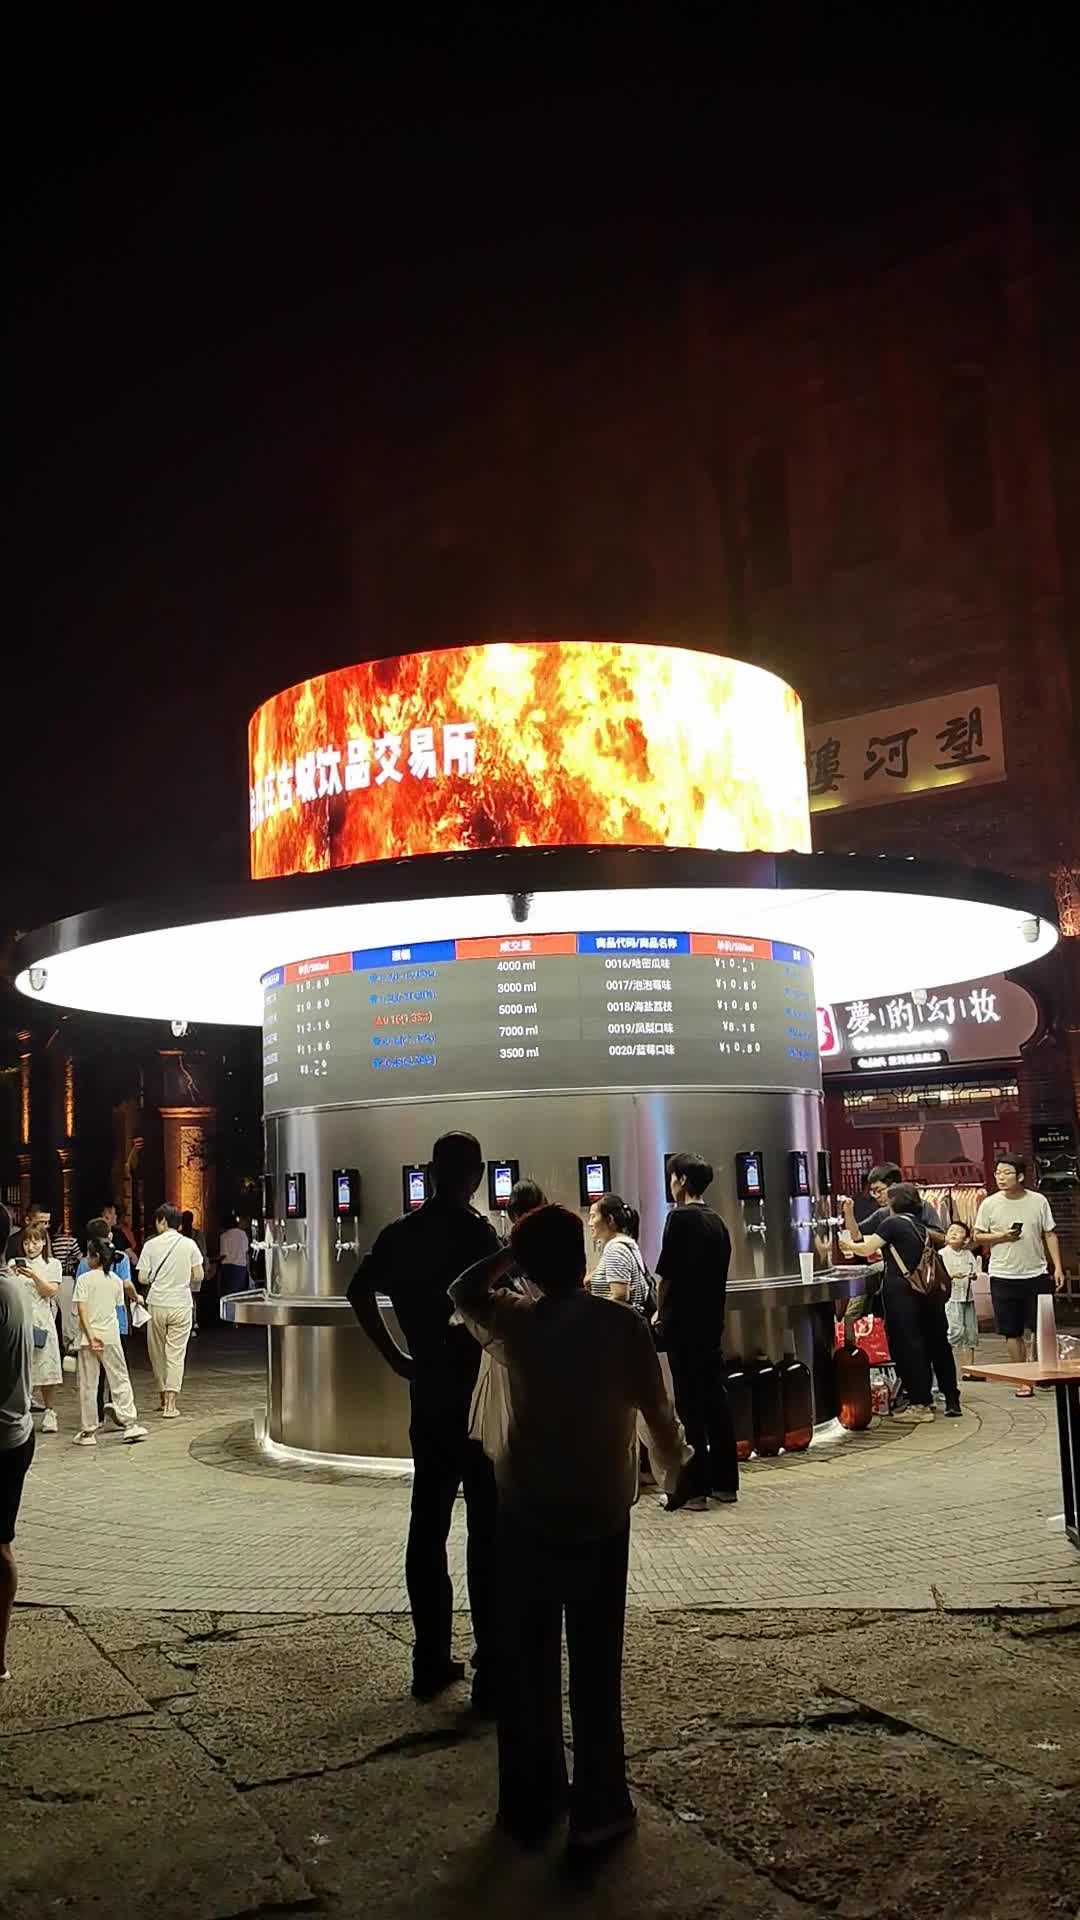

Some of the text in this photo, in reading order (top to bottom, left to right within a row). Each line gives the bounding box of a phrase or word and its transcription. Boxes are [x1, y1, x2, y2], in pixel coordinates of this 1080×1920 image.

[497, 960, 536, 971] 4000 ml
[605, 958, 670, 969] 0016/哈密瓜味
[497, 982, 537, 993] 3000 ml
[498, 1003, 537, 1015] 5000 ml
[607, 1001, 672, 1012] 0018/海盐荔枝
[499, 1025, 538, 1037] 7000 ml
[500, 1047, 539, 1058] 3500 ml
